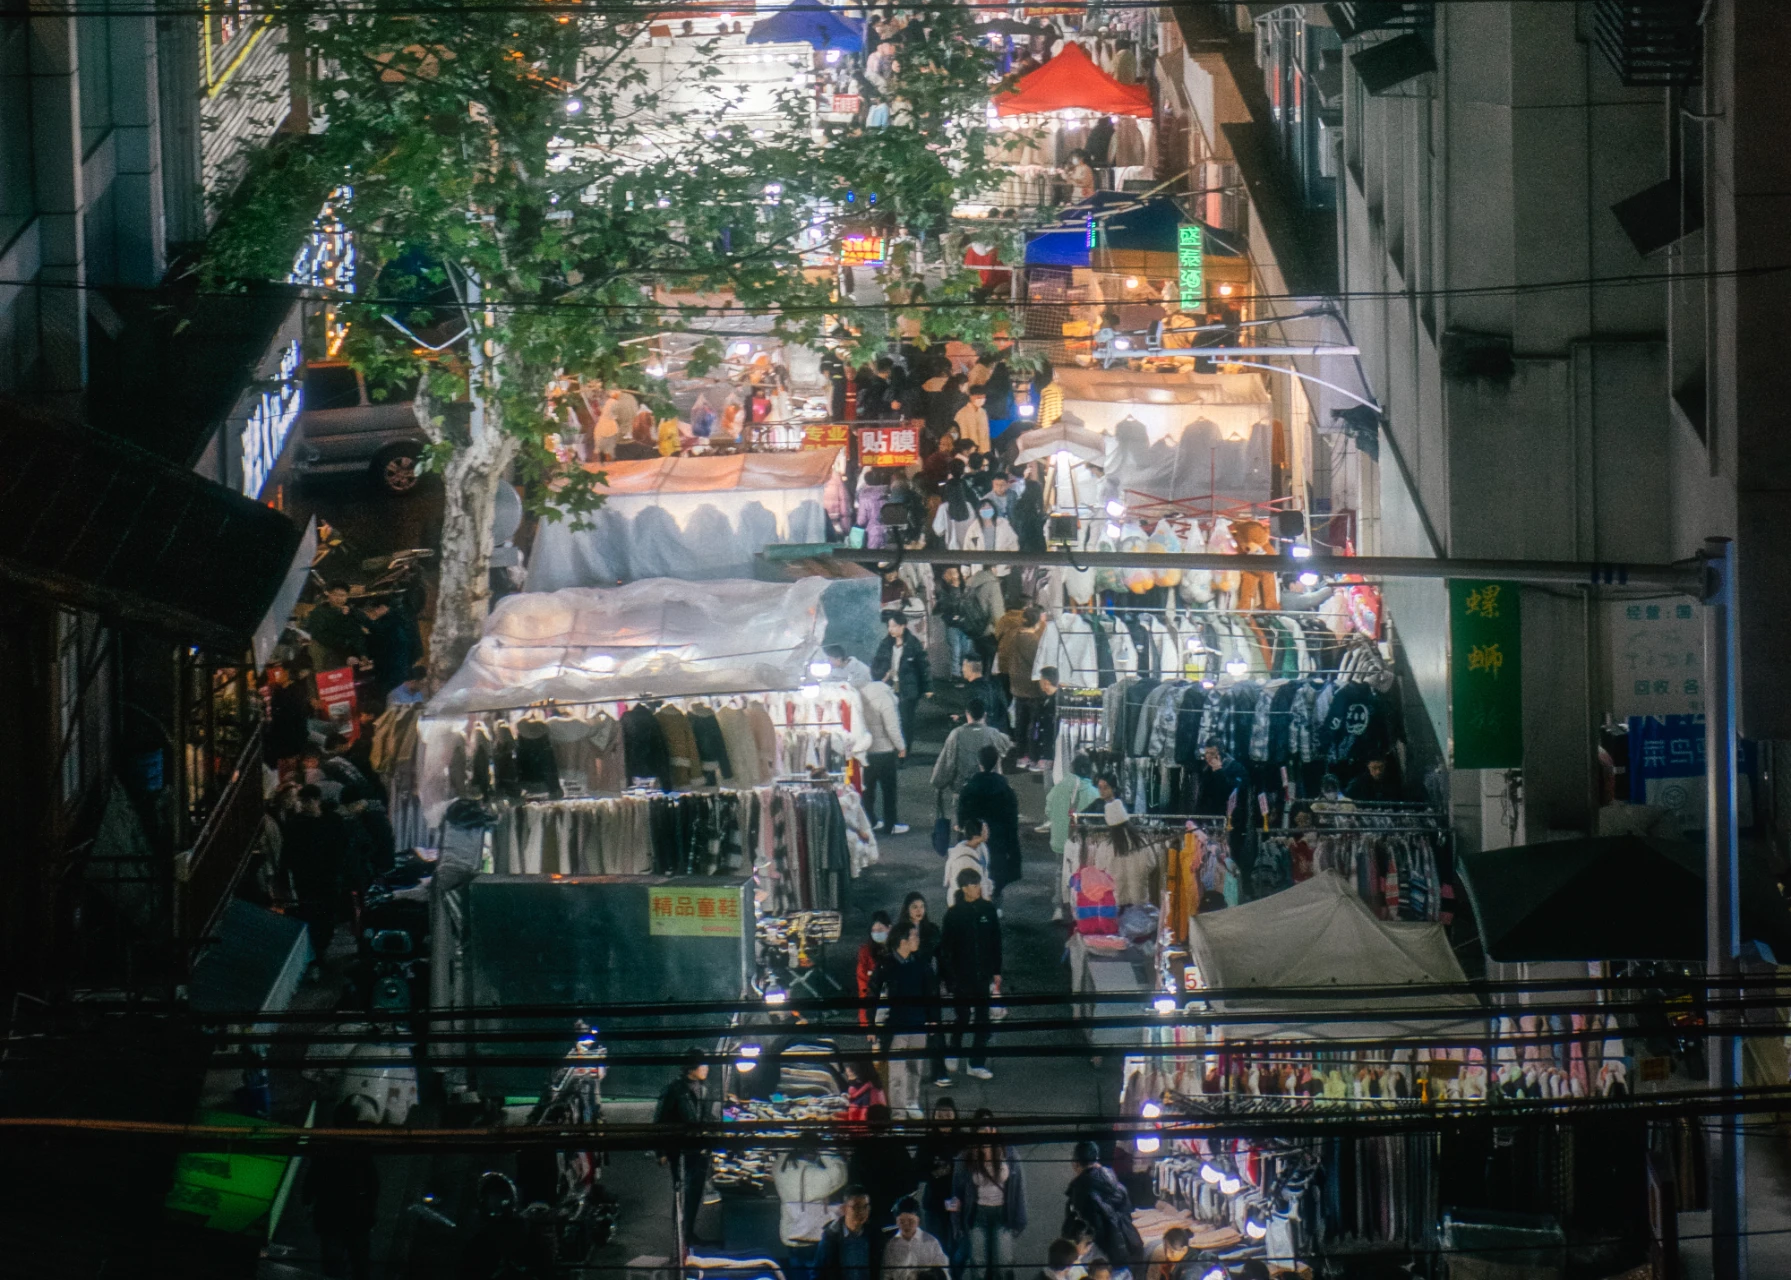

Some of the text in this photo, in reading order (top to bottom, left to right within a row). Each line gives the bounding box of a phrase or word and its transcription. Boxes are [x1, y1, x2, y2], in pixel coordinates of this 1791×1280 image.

[1180, 226, 1202, 310] 盛泰酒店
[805, 425, 848, 441] 专业
[862, 430, 916, 453] 贴膜
[652, 896, 738, 918] 精品童鞋
